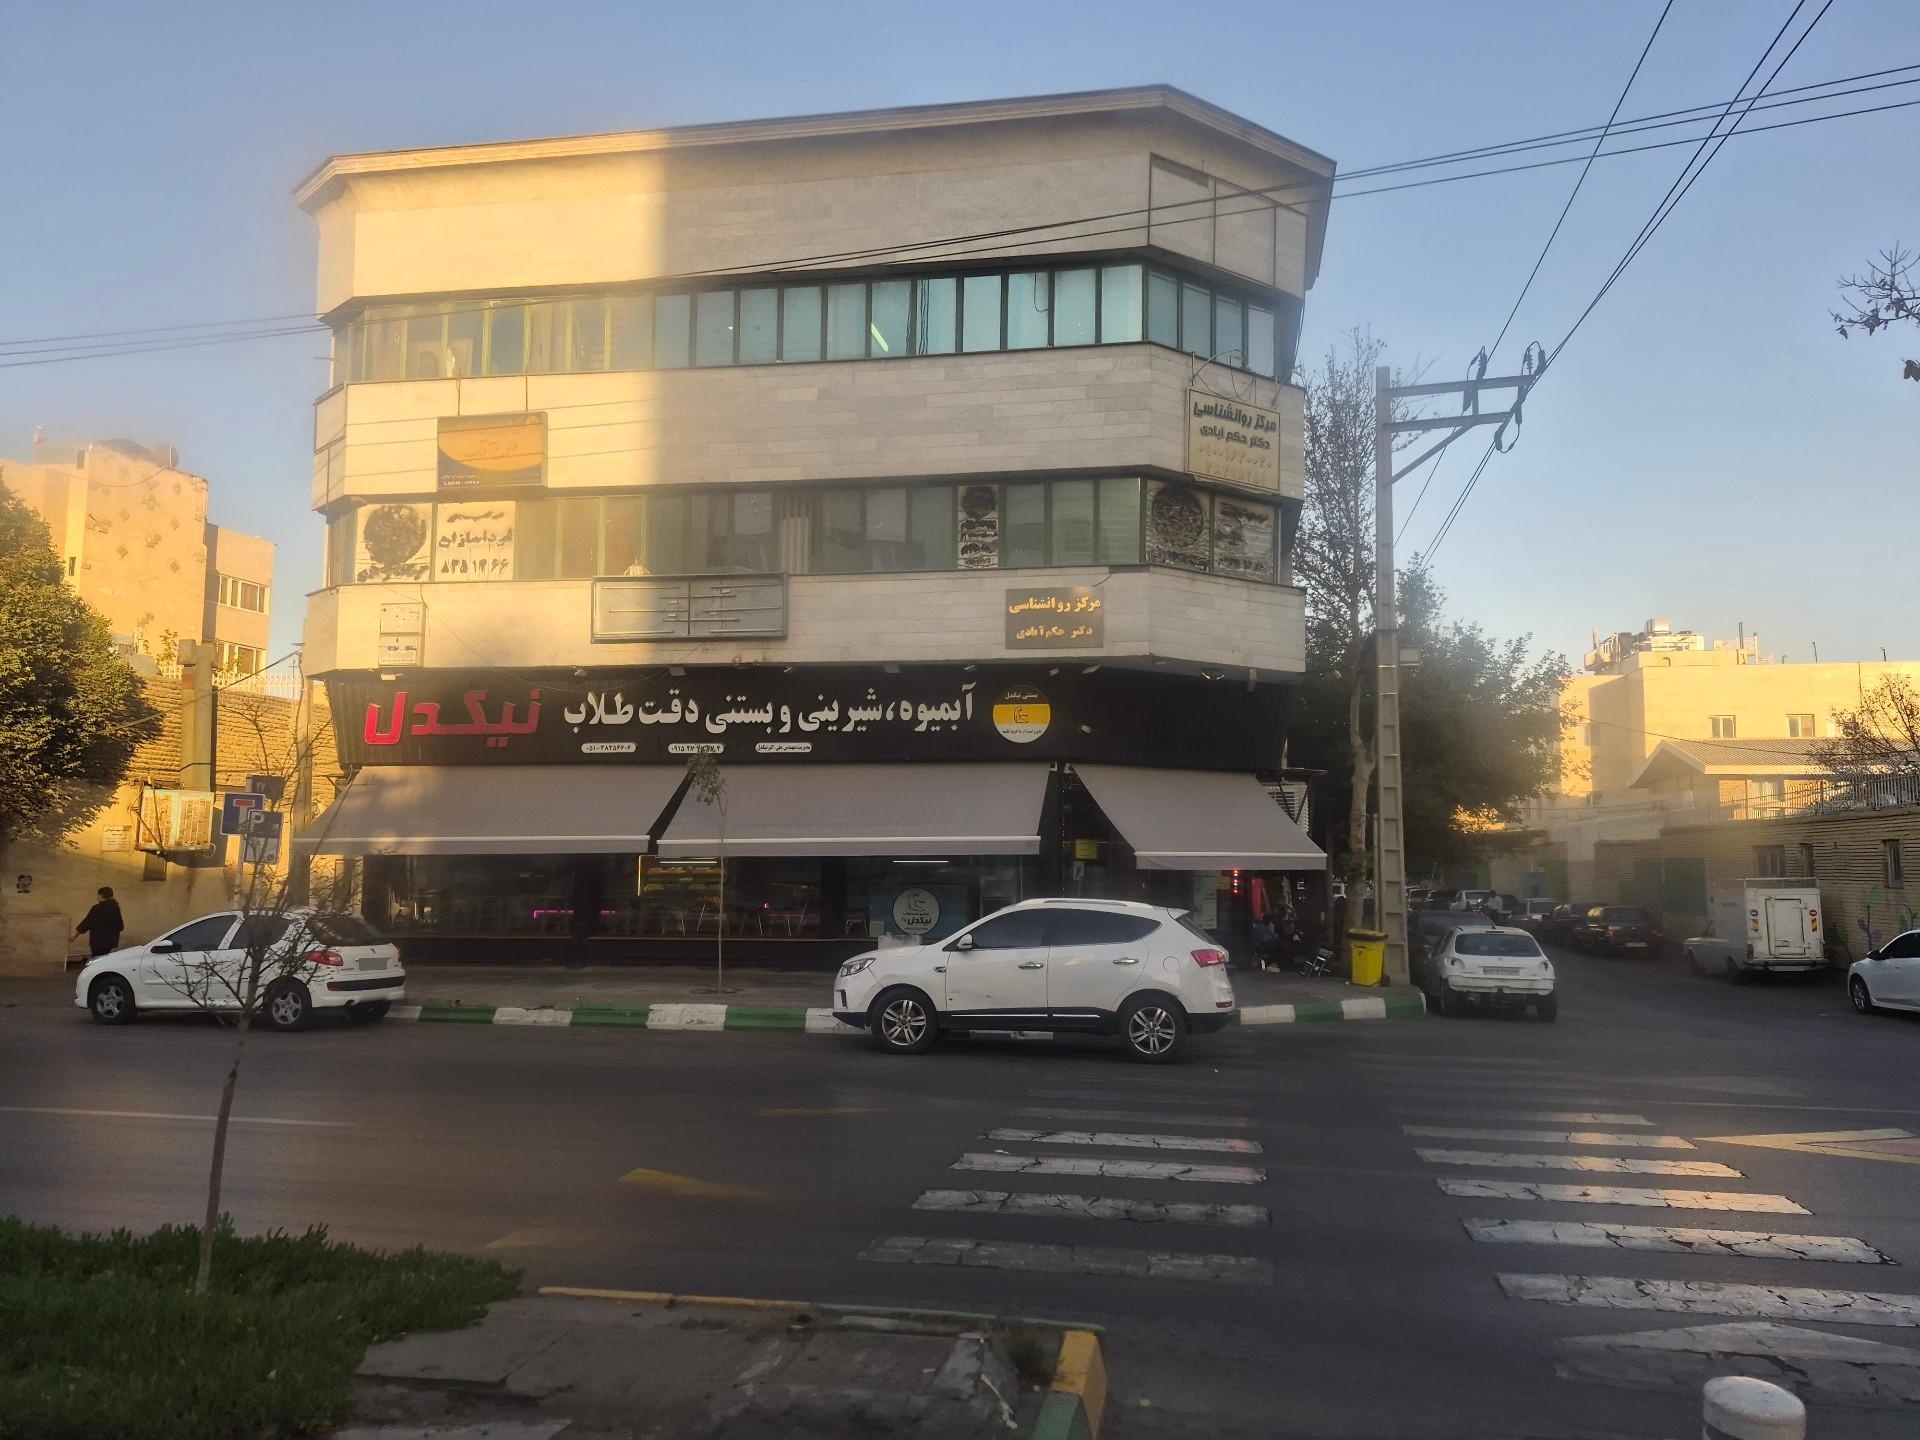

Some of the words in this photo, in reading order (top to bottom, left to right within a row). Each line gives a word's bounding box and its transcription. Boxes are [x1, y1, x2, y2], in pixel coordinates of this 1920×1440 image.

[1193, 401, 1252, 428] روانشناسی
[1253, 413, 1277, 433] مرکز
[1226, 430, 1248, 445] حکم
[1248, 435, 1271, 449] دکتر
[1008, 596, 1071, 614] روانشناسی
[1073, 596, 1101, 612] مرکز
[1070, 625, 1093, 638] دکتر
[563, 691, 634, 734] طلاب
[638, 688, 699, 724] دقت
[705, 695, 774, 734] بستنی
[778, 701, 792, 733] و
[798, 687, 882, 733] شیرینی
[364, 688, 542, 748] نیکدل
[251, 812, 265, 831] P
